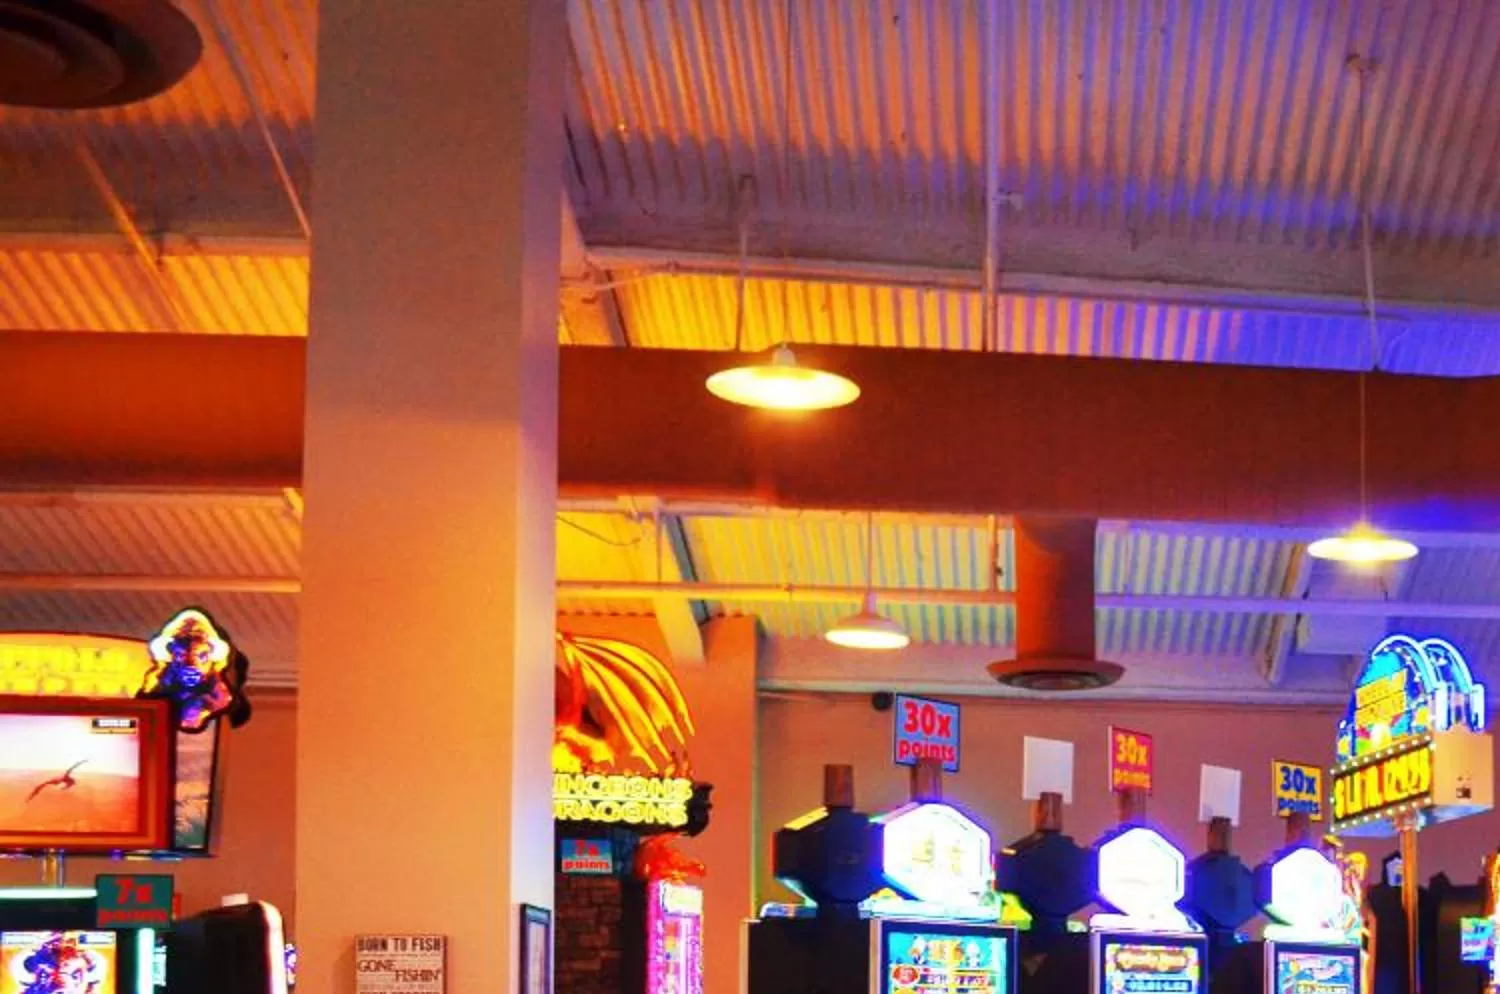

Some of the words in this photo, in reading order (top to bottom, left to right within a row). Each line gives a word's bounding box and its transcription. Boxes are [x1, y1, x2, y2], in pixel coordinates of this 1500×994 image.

[903, 699, 953, 739] 30x
[898, 739, 956, 763] points
[1114, 734, 1150, 767] 30x
[1280, 765, 1317, 796] 30x
[412, 937, 441, 952] FISH
[358, 960, 395, 973] GONE
